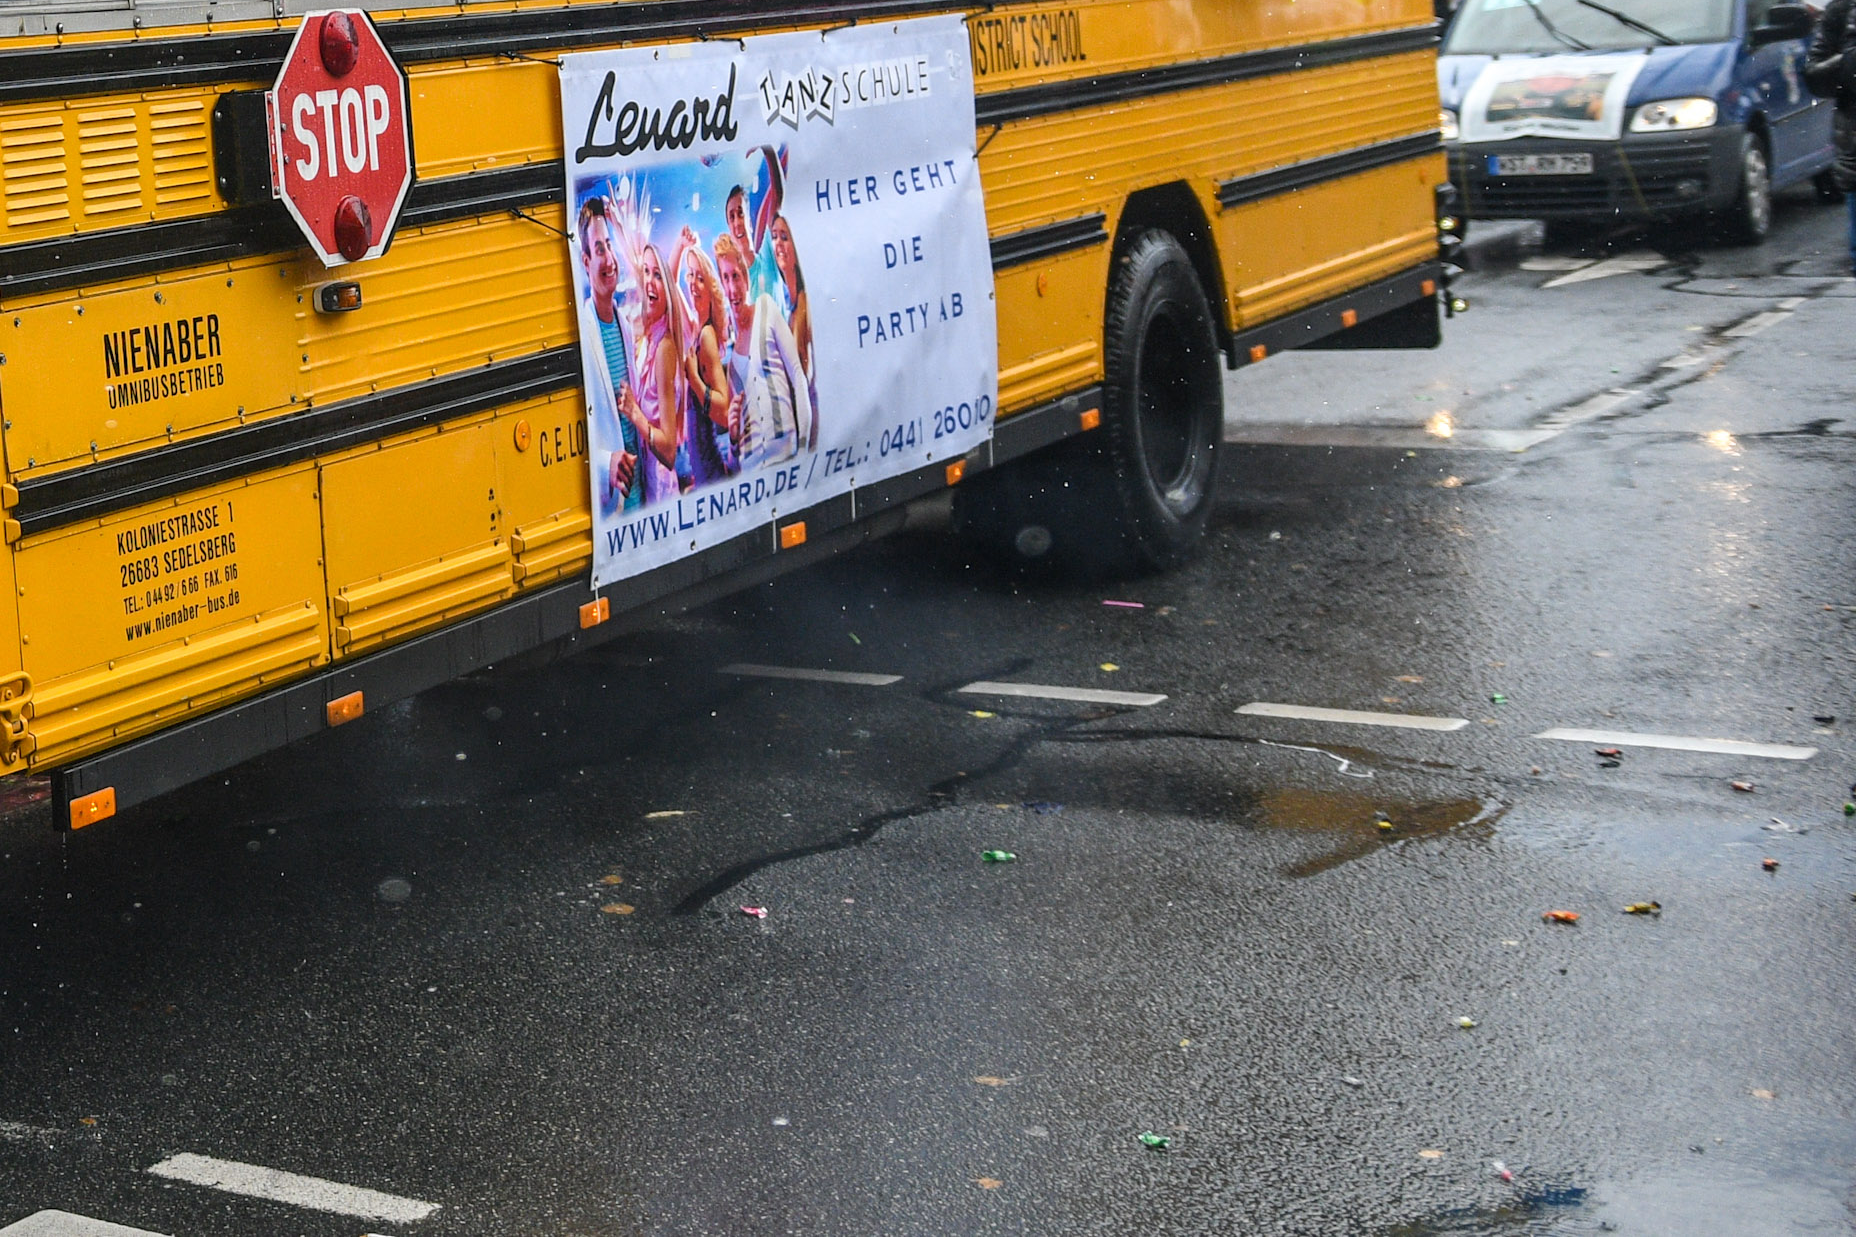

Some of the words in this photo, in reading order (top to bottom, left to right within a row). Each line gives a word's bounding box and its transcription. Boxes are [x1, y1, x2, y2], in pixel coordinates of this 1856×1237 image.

[970, 15, 1027, 76] ISTRICT
[1031, 10, 1086, 68] SCHOOL
[292, 84, 390, 181] STOP
[575, 61, 738, 164] Lenard
[815, 177, 879, 213] HIER
[893, 159, 957, 196] GEHT
[883, 235, 923, 270] DIE
[103, 314, 222, 379] NIENABER
[857, 302, 929, 349] PARTY
[939, 292, 964, 323] AB
[107, 363, 225, 410] OMNIBUSBETRIEB
[569, 419, 587, 458] LO
[607, 464, 801, 557] WWW.LENARD.DE
[880, 416, 924, 459] 0441
[934, 394, 991, 440] 26010
[117, 505, 220, 556] KOLONIESTRASSE
[227, 501, 234, 523] 1
[120, 555, 159, 588] 26683
[163, 532, 236, 574] SEDELSBERG
[204, 569, 223, 589] FAX.
[225, 563, 238, 583] 616
[125, 588, 241, 642] www.nienaber-bus.de
